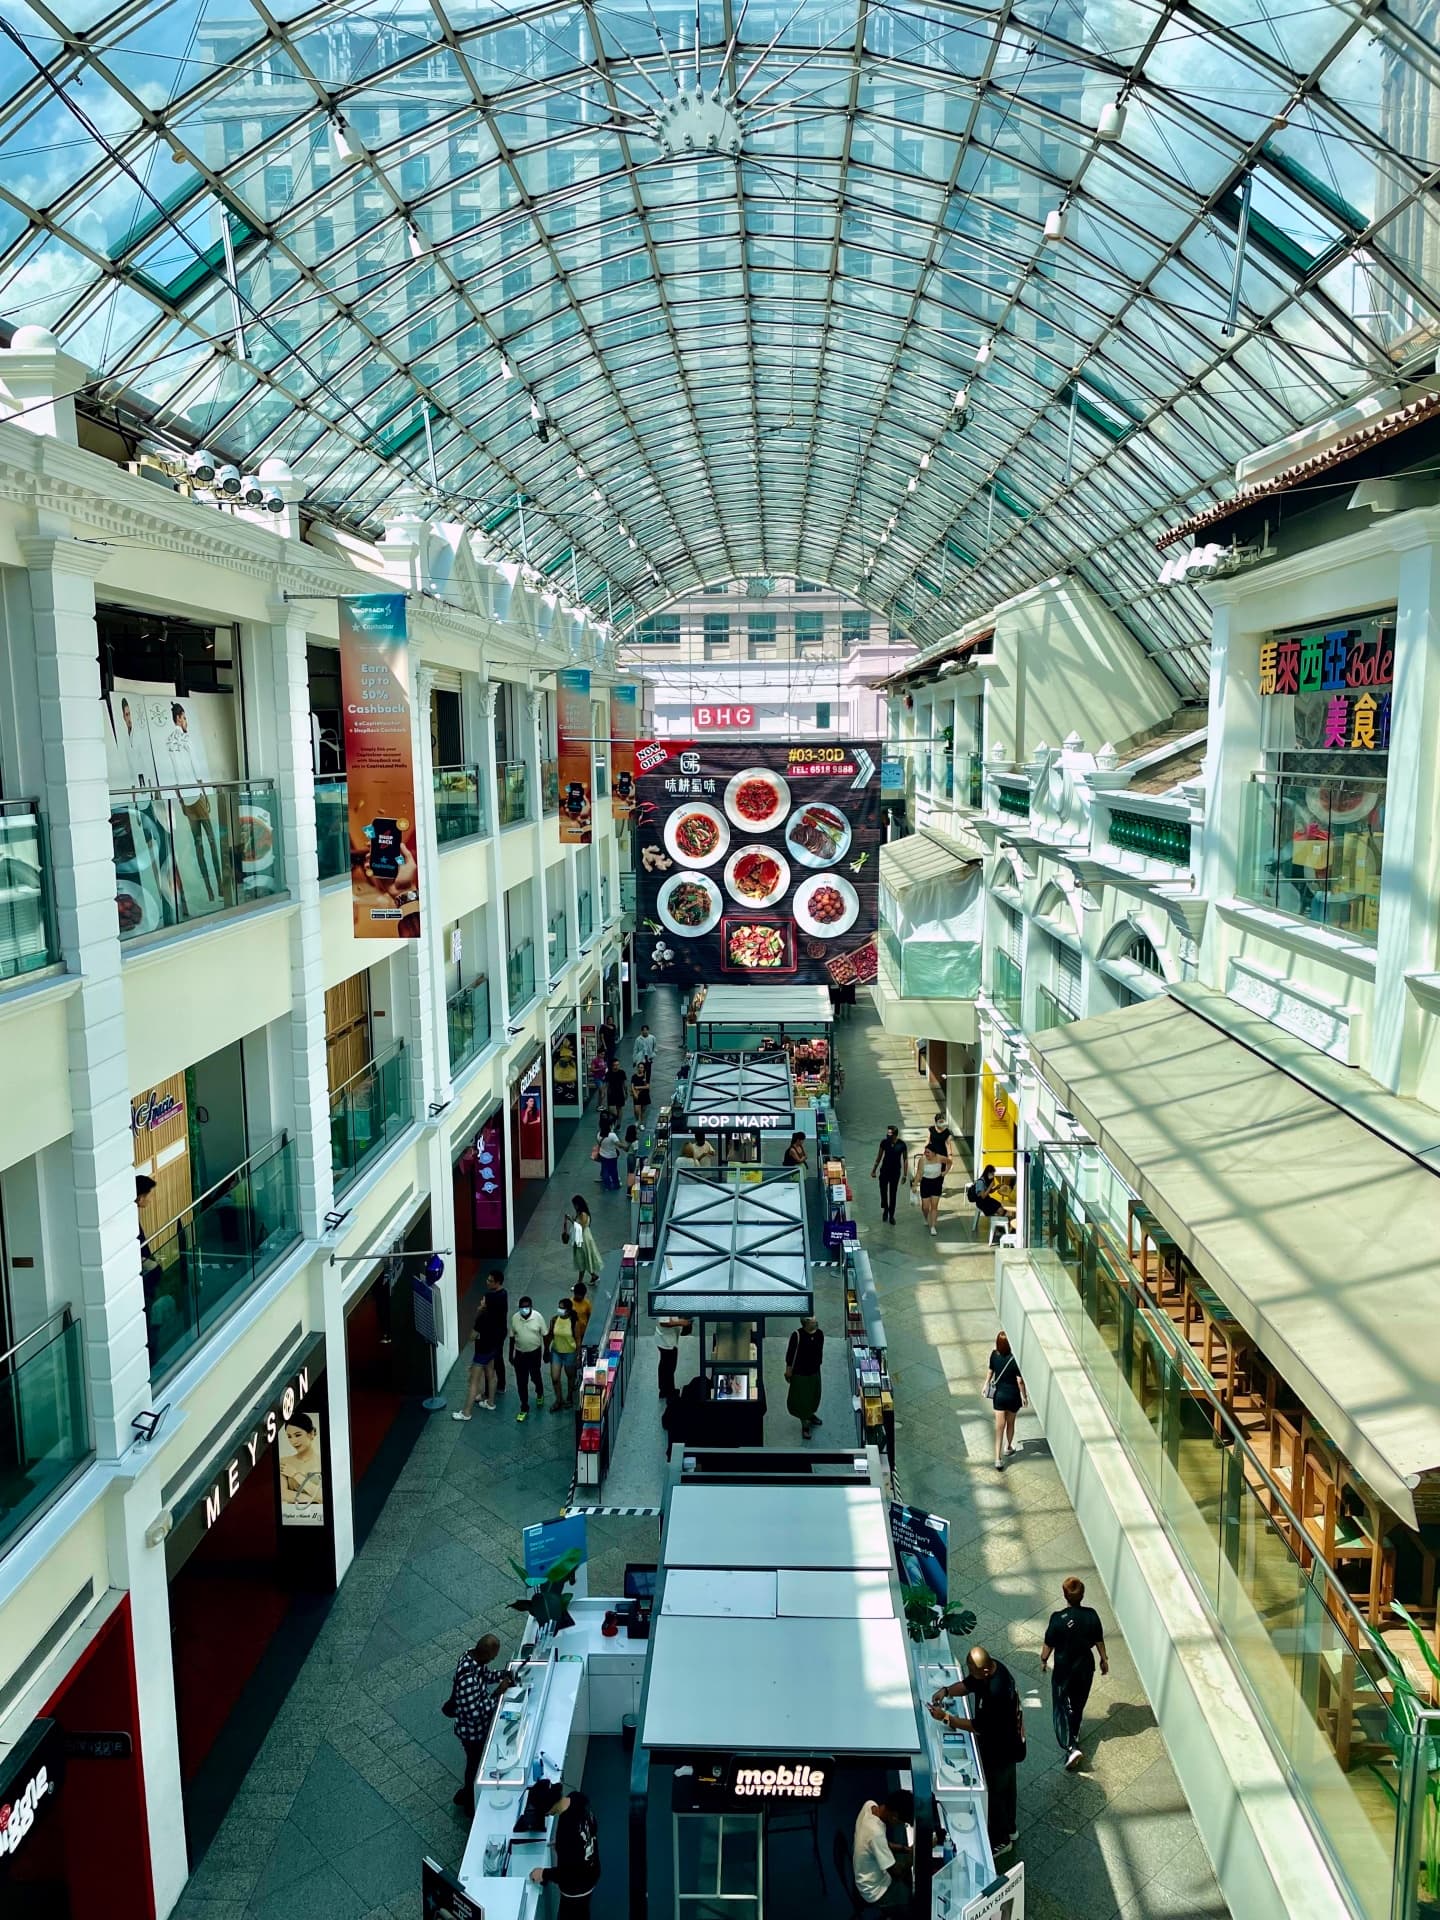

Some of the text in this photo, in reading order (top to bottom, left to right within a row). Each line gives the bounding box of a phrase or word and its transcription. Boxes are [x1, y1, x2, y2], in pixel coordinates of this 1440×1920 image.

[361, 663, 388, 673] Earn
[1260, 630, 1348, 695] 馬來西亞
[361, 679, 376, 687] up
[361, 690, 388, 700] 50%
[348, 704, 405, 714] Cashback
[698, 708, 751, 725] BHG
[637, 742, 660, 759] NOW
[788, 748, 845, 762] #03-30D
[641, 751, 667, 769] OPEN
[793, 766, 808, 774] TEL:
[698, 1115, 780, 1128] POP MART
[736, 1765, 825, 1787] mobile
[735, 1784, 822, 1797] OUTFITTERS
